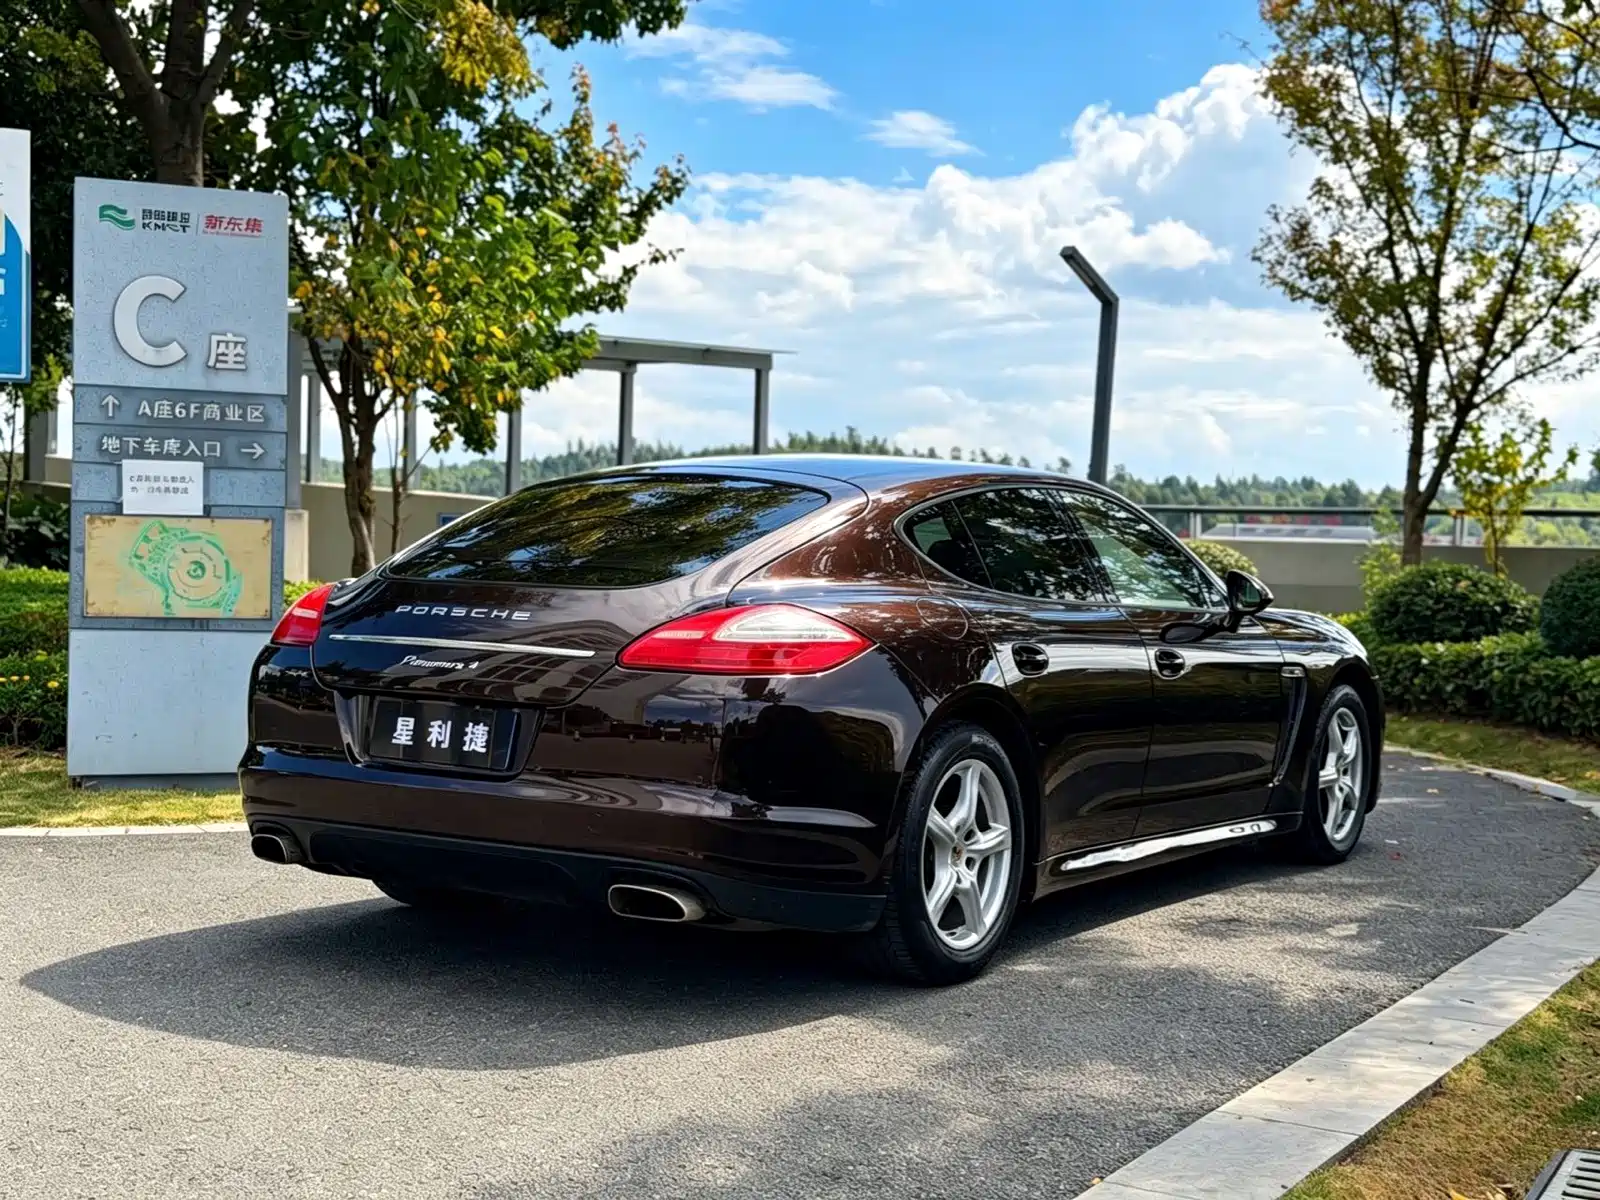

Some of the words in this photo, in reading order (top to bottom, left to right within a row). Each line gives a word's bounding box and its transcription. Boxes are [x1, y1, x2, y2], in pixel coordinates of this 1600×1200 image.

[138, 400, 265, 422] A座6F商业区
[101, 436, 221, 457] 地下车库入口
[395, 605, 532, 621] PORSCHE
[391, 716, 490, 753] 星利捷
